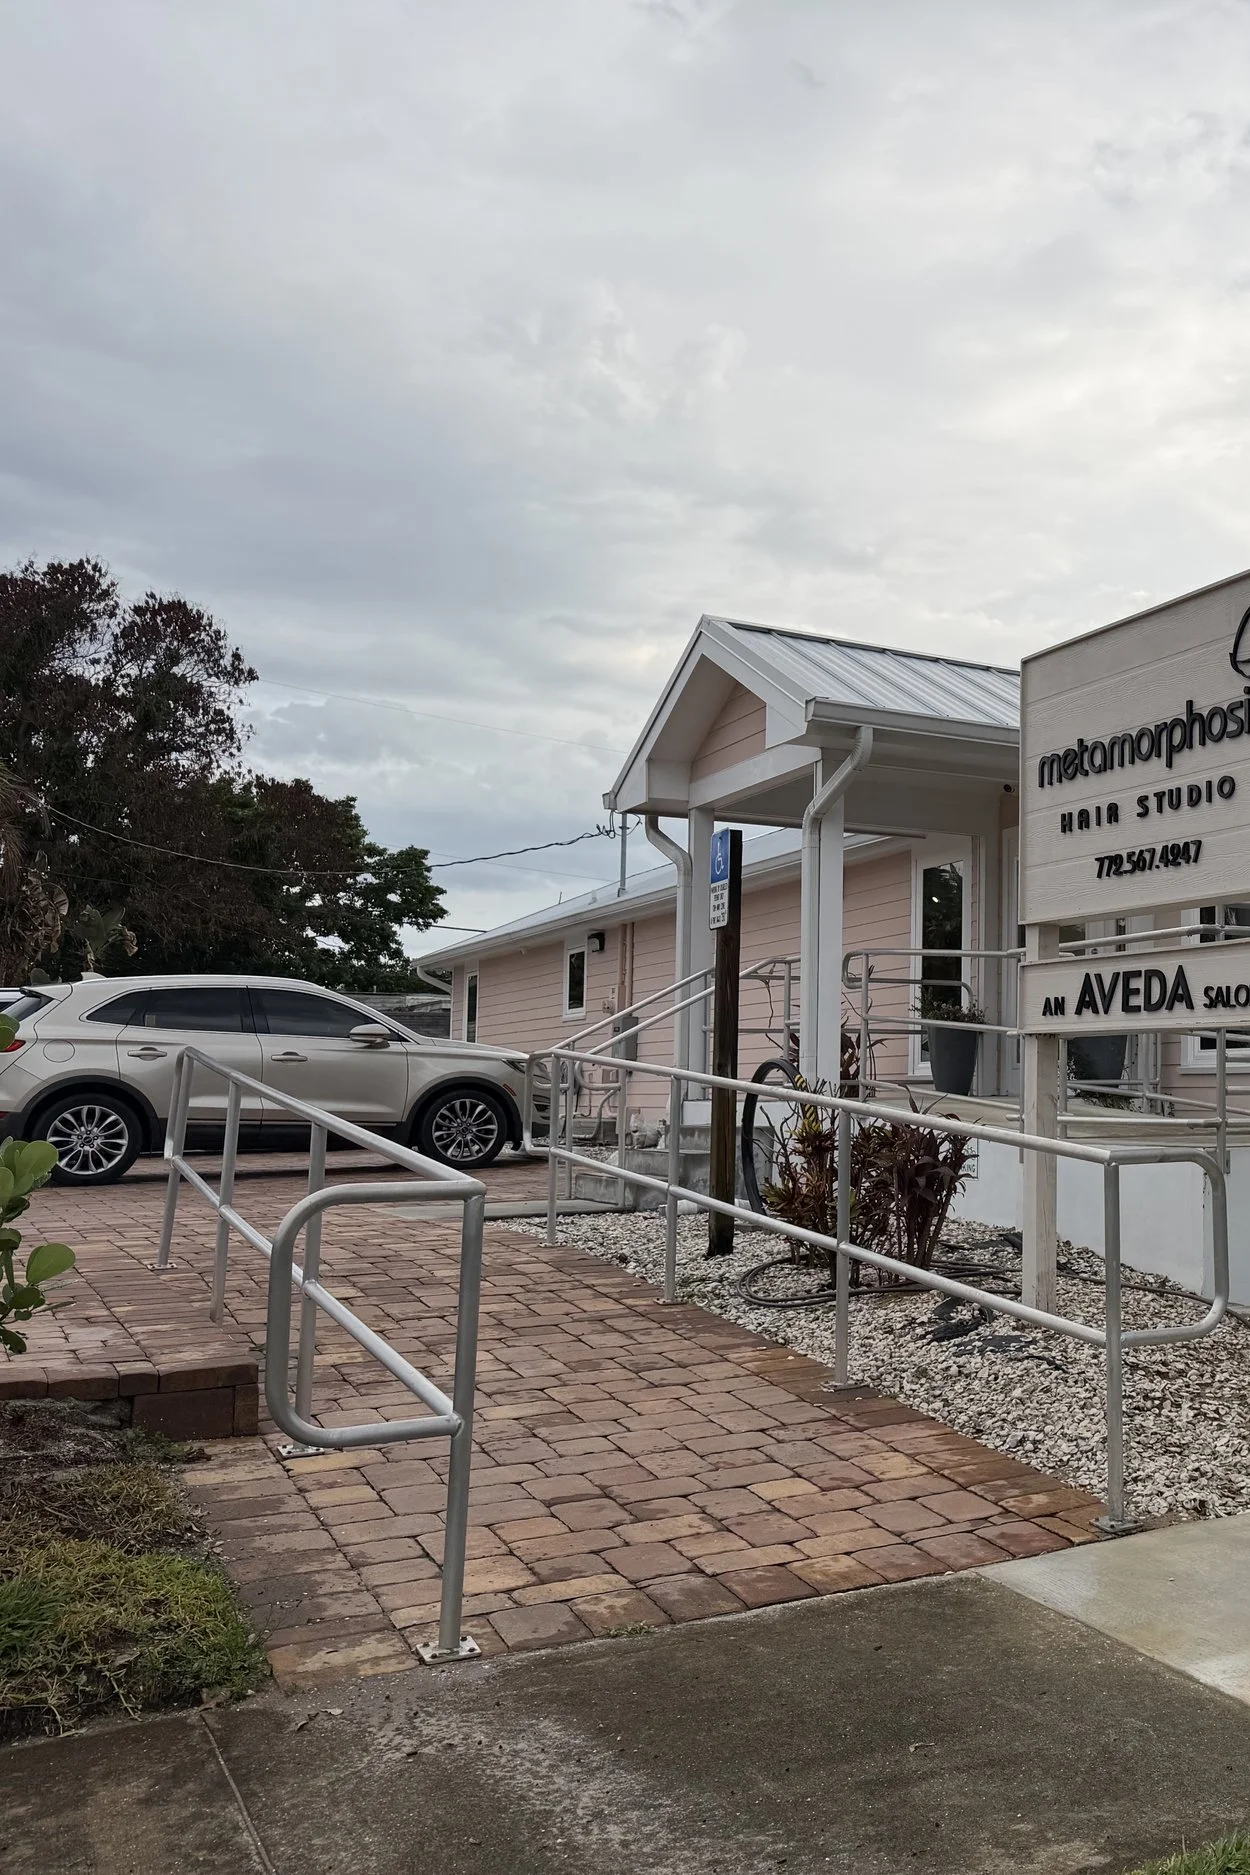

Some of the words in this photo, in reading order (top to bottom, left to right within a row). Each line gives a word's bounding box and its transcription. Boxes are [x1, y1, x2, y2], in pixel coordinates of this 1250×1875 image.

[1060, 802, 1119, 833] HAIR
[1136, 775, 1236, 817] STUDIO
[1094, 840, 1203, 879] 772.567.4247
[1042, 996, 1066, 1017] AN
[1074, 964, 1195, 1016] AVEDA
